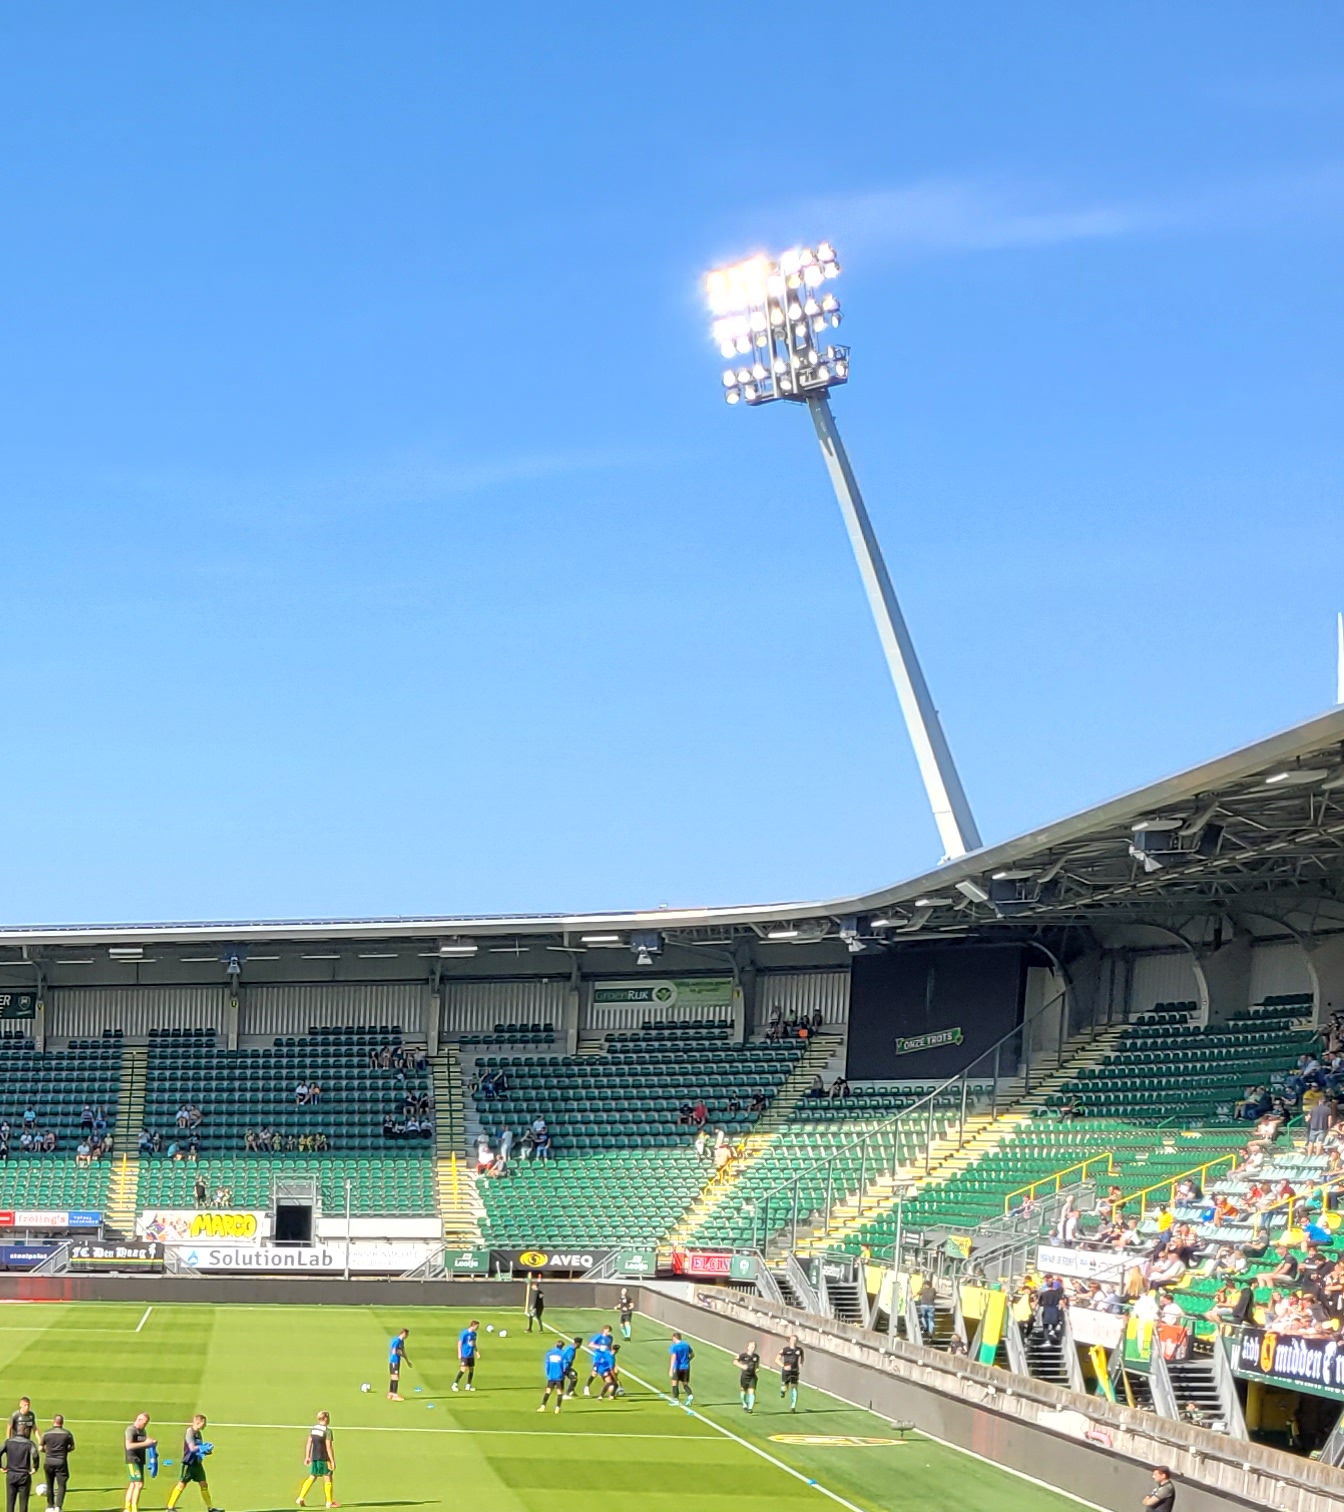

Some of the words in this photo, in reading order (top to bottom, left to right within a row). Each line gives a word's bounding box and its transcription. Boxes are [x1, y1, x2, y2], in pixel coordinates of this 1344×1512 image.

[9, 1252, 47, 1261] steelpoint
[208, 1249, 333, 1267] SolutionLab
[550, 1254, 594, 1268] AVEQ
[1275, 1338, 1323, 1380] midden
